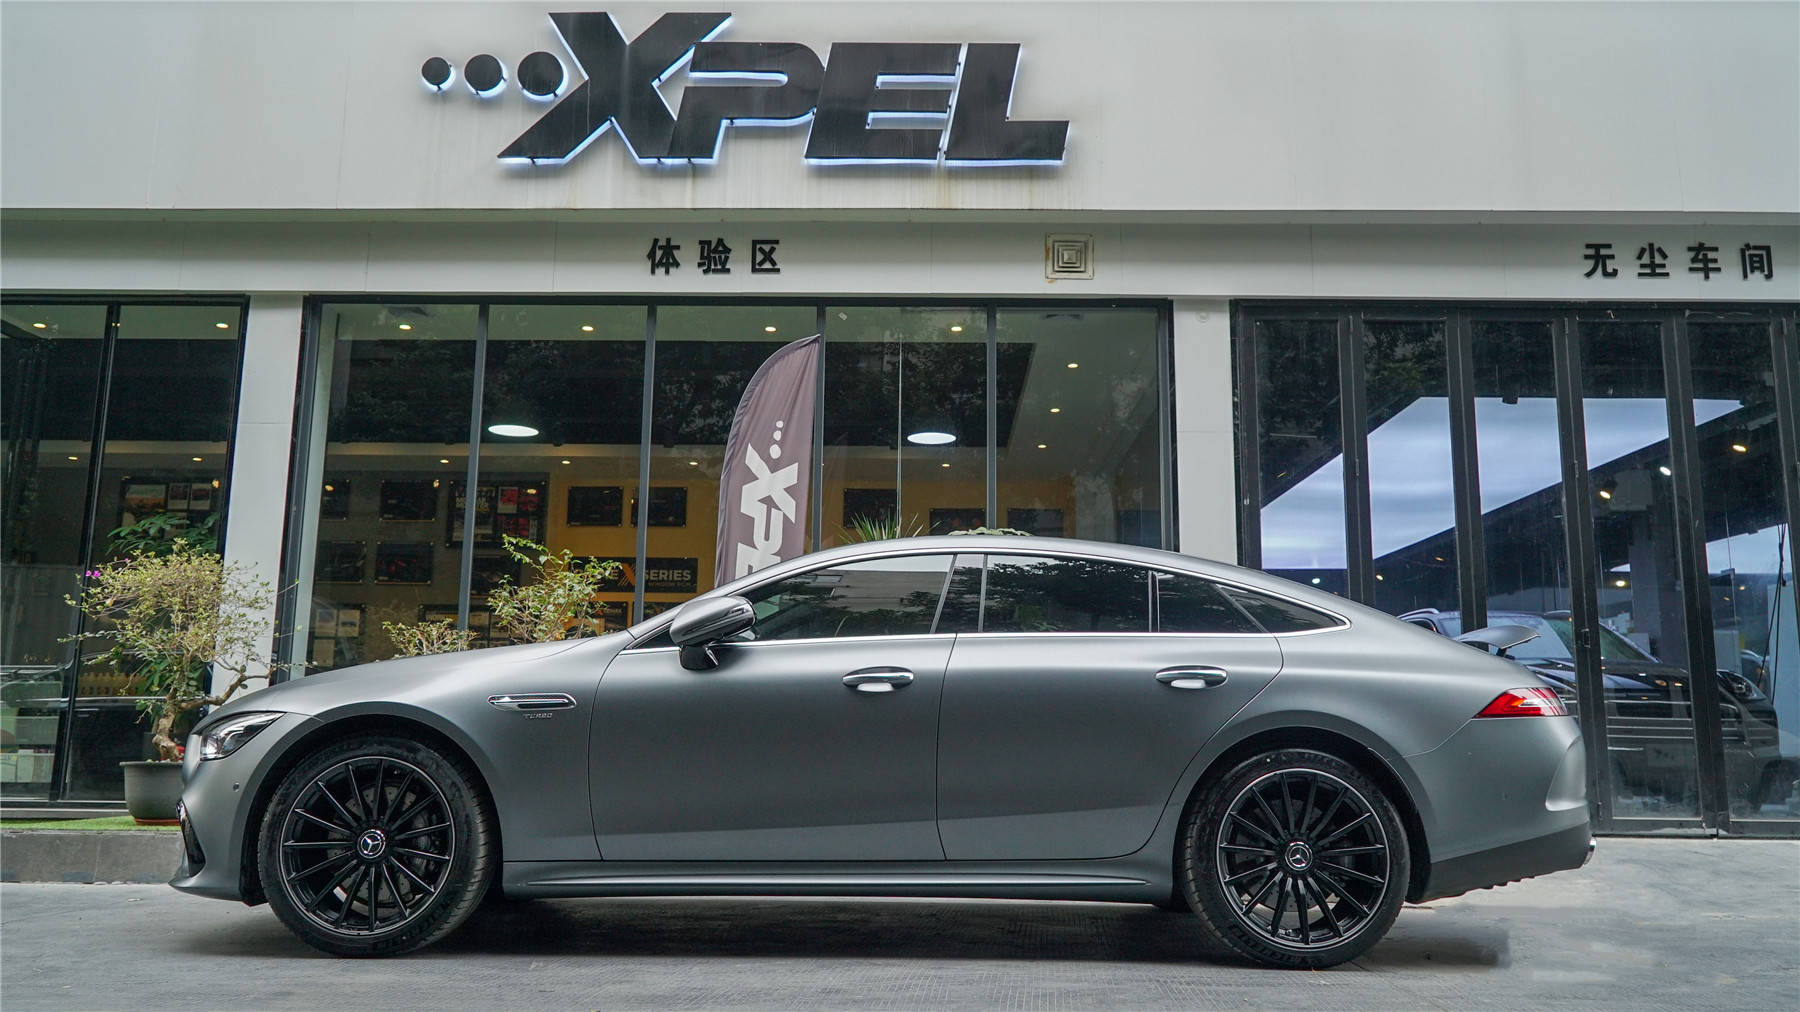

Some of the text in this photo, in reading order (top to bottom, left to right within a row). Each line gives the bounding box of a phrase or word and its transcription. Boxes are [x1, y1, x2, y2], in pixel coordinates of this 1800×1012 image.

[498, 12, 1070, 164] XPEL
[647, 237, 781, 275] 体验区
[1583, 242, 1774, 280] 无尘车间
